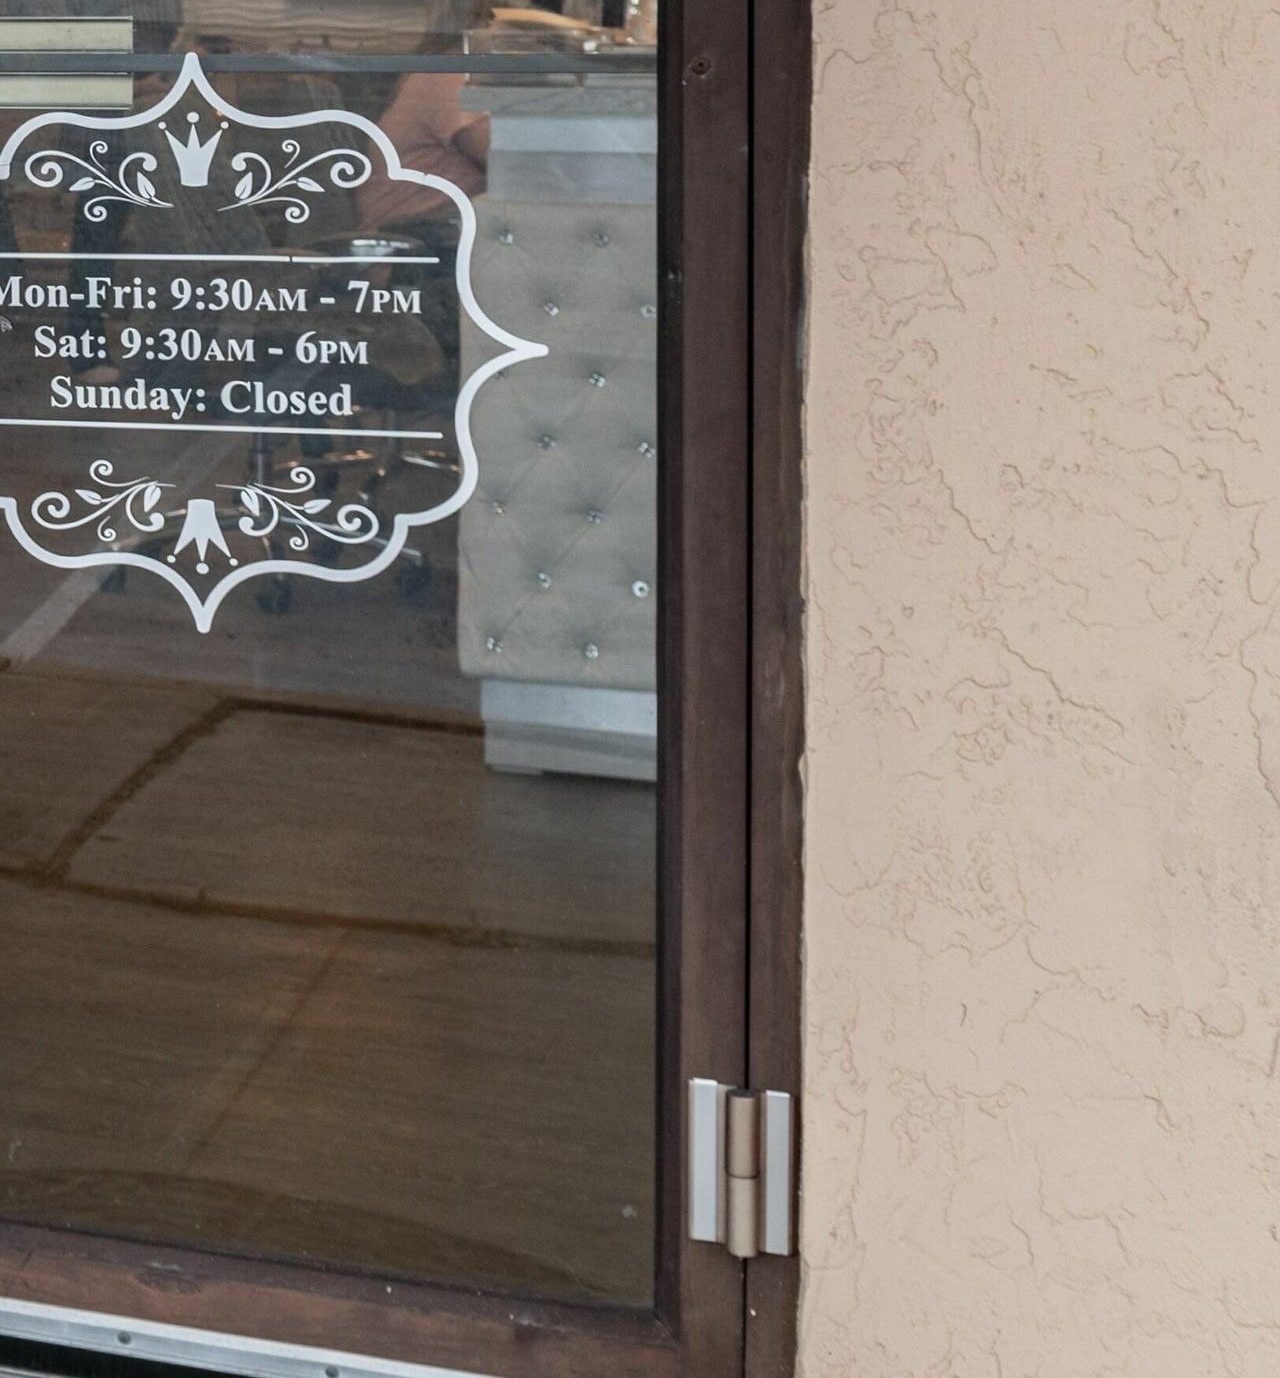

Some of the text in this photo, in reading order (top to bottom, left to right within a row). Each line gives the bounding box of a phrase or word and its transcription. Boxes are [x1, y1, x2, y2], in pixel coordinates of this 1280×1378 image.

[170, 277, 308, 313] 9:30AM
[346, 280, 423, 314] 7PM
[34, 325, 108, 360] Sat:
[120, 327, 256, 363] 9:30AM
[295, 330, 369, 365] 6PM
[49, 375, 354, 420] Sunday: Closed
